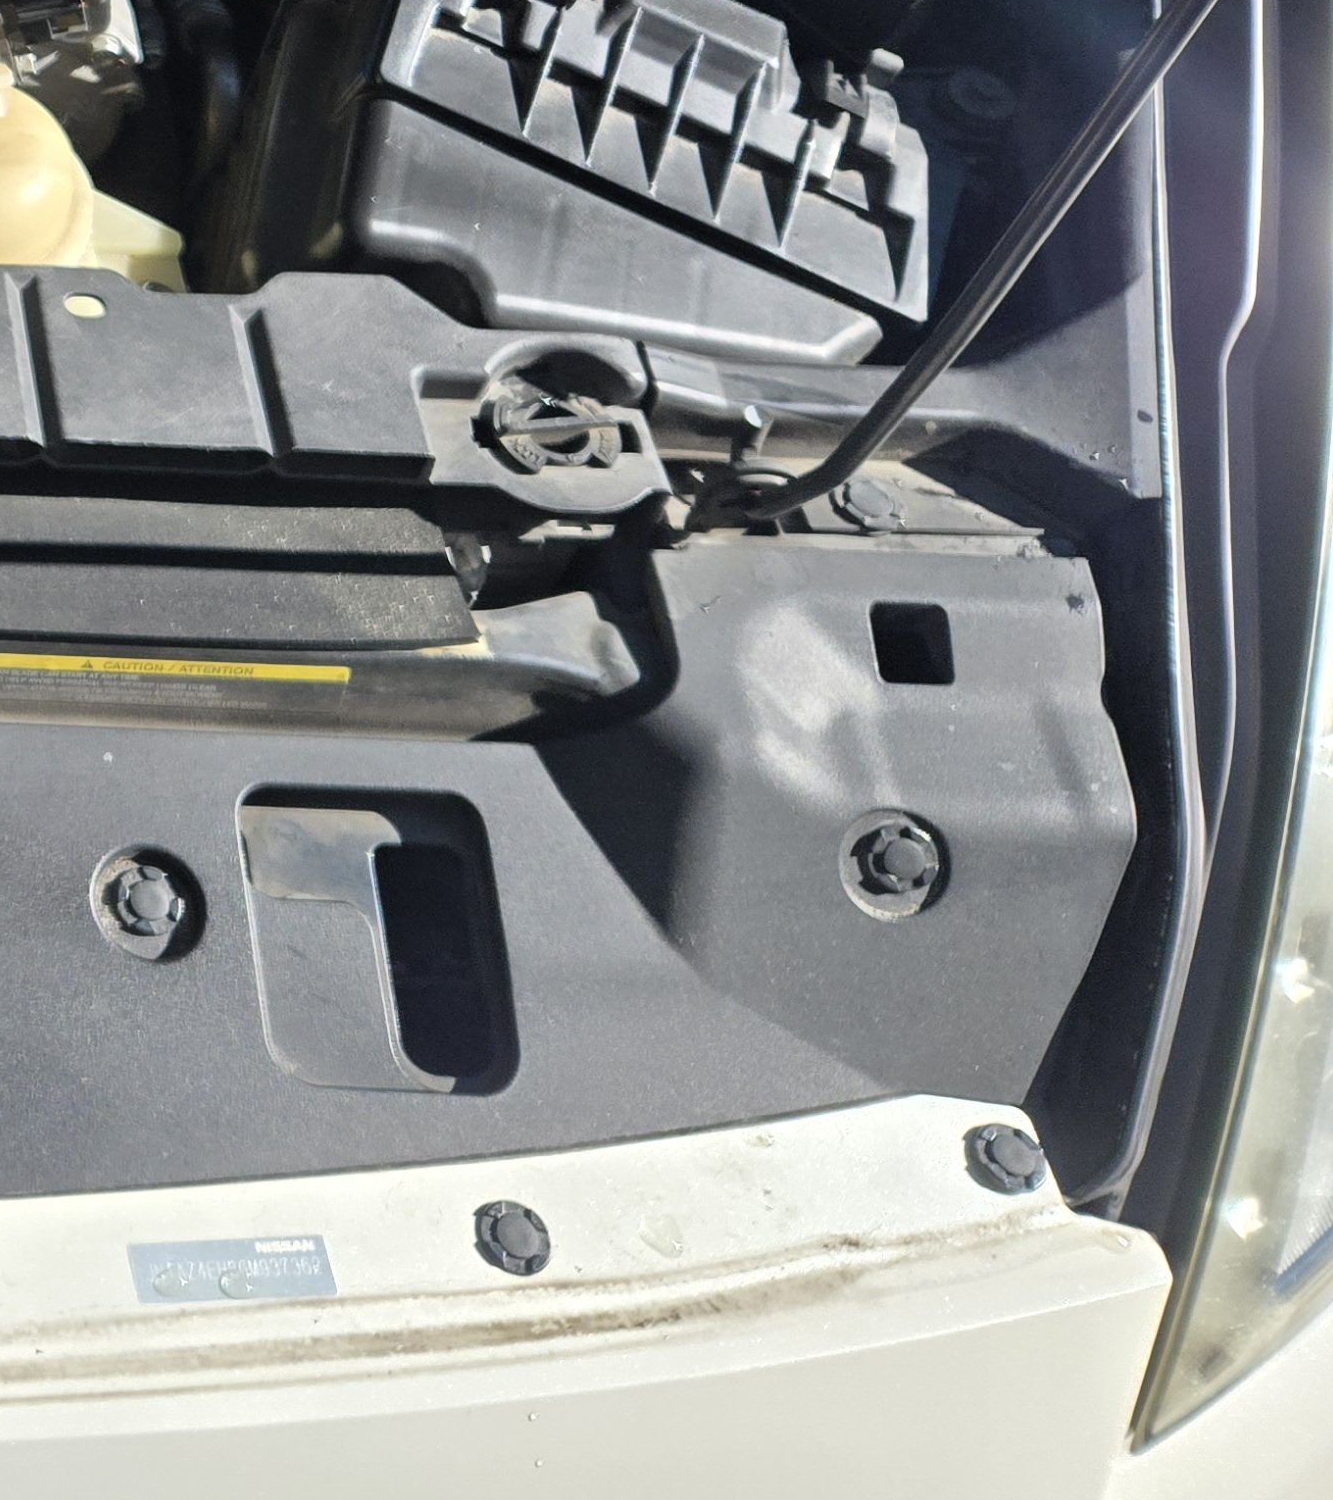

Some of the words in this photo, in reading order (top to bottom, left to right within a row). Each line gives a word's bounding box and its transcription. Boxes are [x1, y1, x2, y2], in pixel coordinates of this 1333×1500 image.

[103, 660, 164, 671] CAUTION
[179, 664, 255, 676] ATTENTION
[254, 1238, 316, 1254] NISSAN
